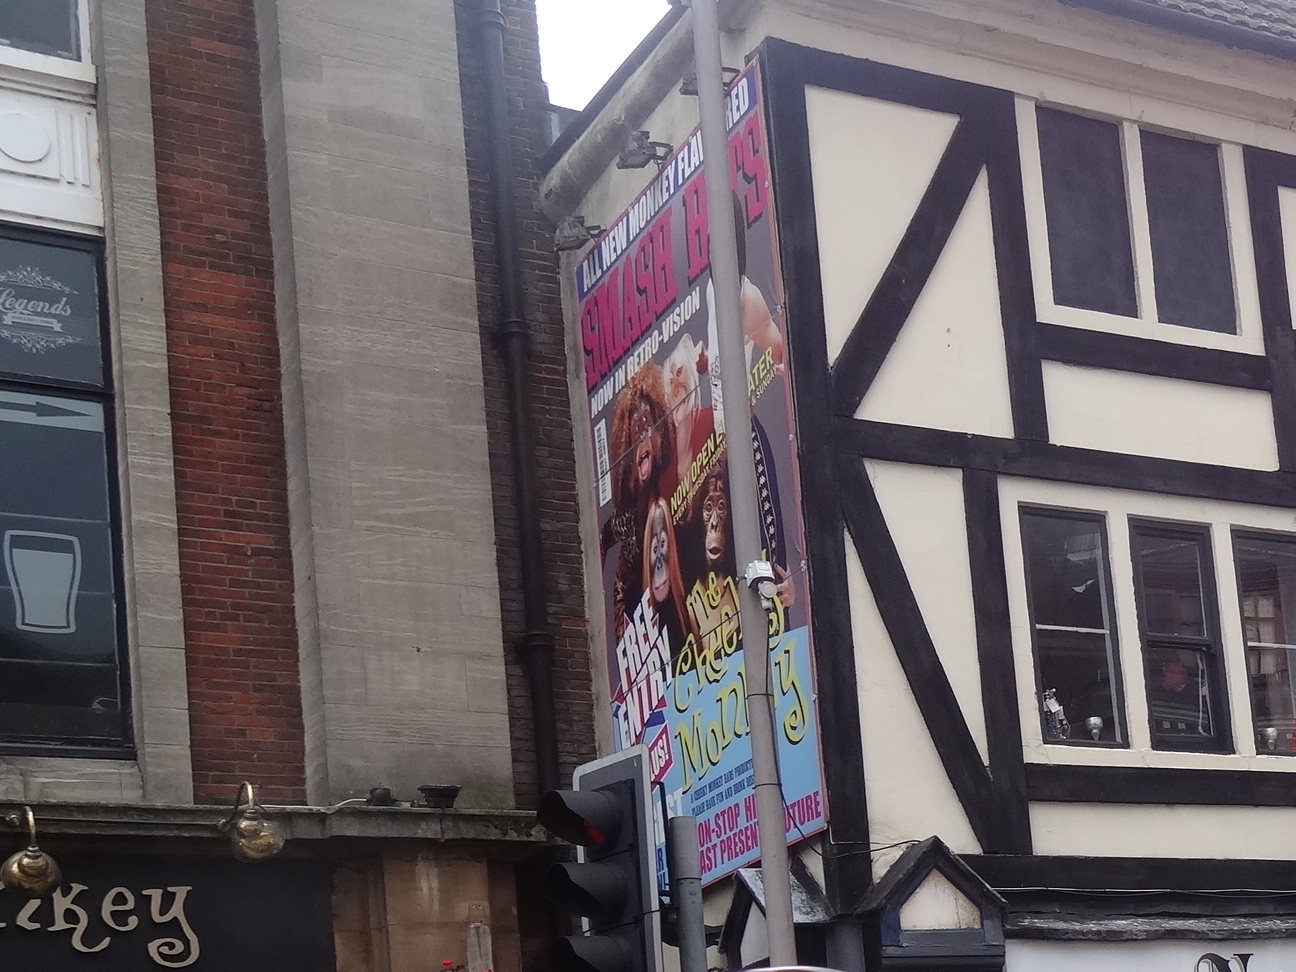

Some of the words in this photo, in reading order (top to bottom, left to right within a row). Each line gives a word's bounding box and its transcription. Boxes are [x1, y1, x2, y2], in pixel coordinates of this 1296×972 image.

[583, 246, 601, 292] ALL
[602, 216, 628, 267] NEW
[629, 159, 675, 241] MONKEY
[580, 204, 679, 391] SMASH
[591, 375, 614, 419] NOW
[615, 363, 627, 396] IN
[627, 286, 701, 384] RETRO-VISION
[670, 472, 691, 516] NOW
[692, 432, 715, 482] OPEN
[747, 346, 774, 397] ATER
[616, 587, 659, 697] FREE
[618, 625, 673, 750] ENTRY
[697, 802, 740, 848] ON-STOP
[700, 843, 719, 877] AST
[784, 790, 822, 835] UTURE
